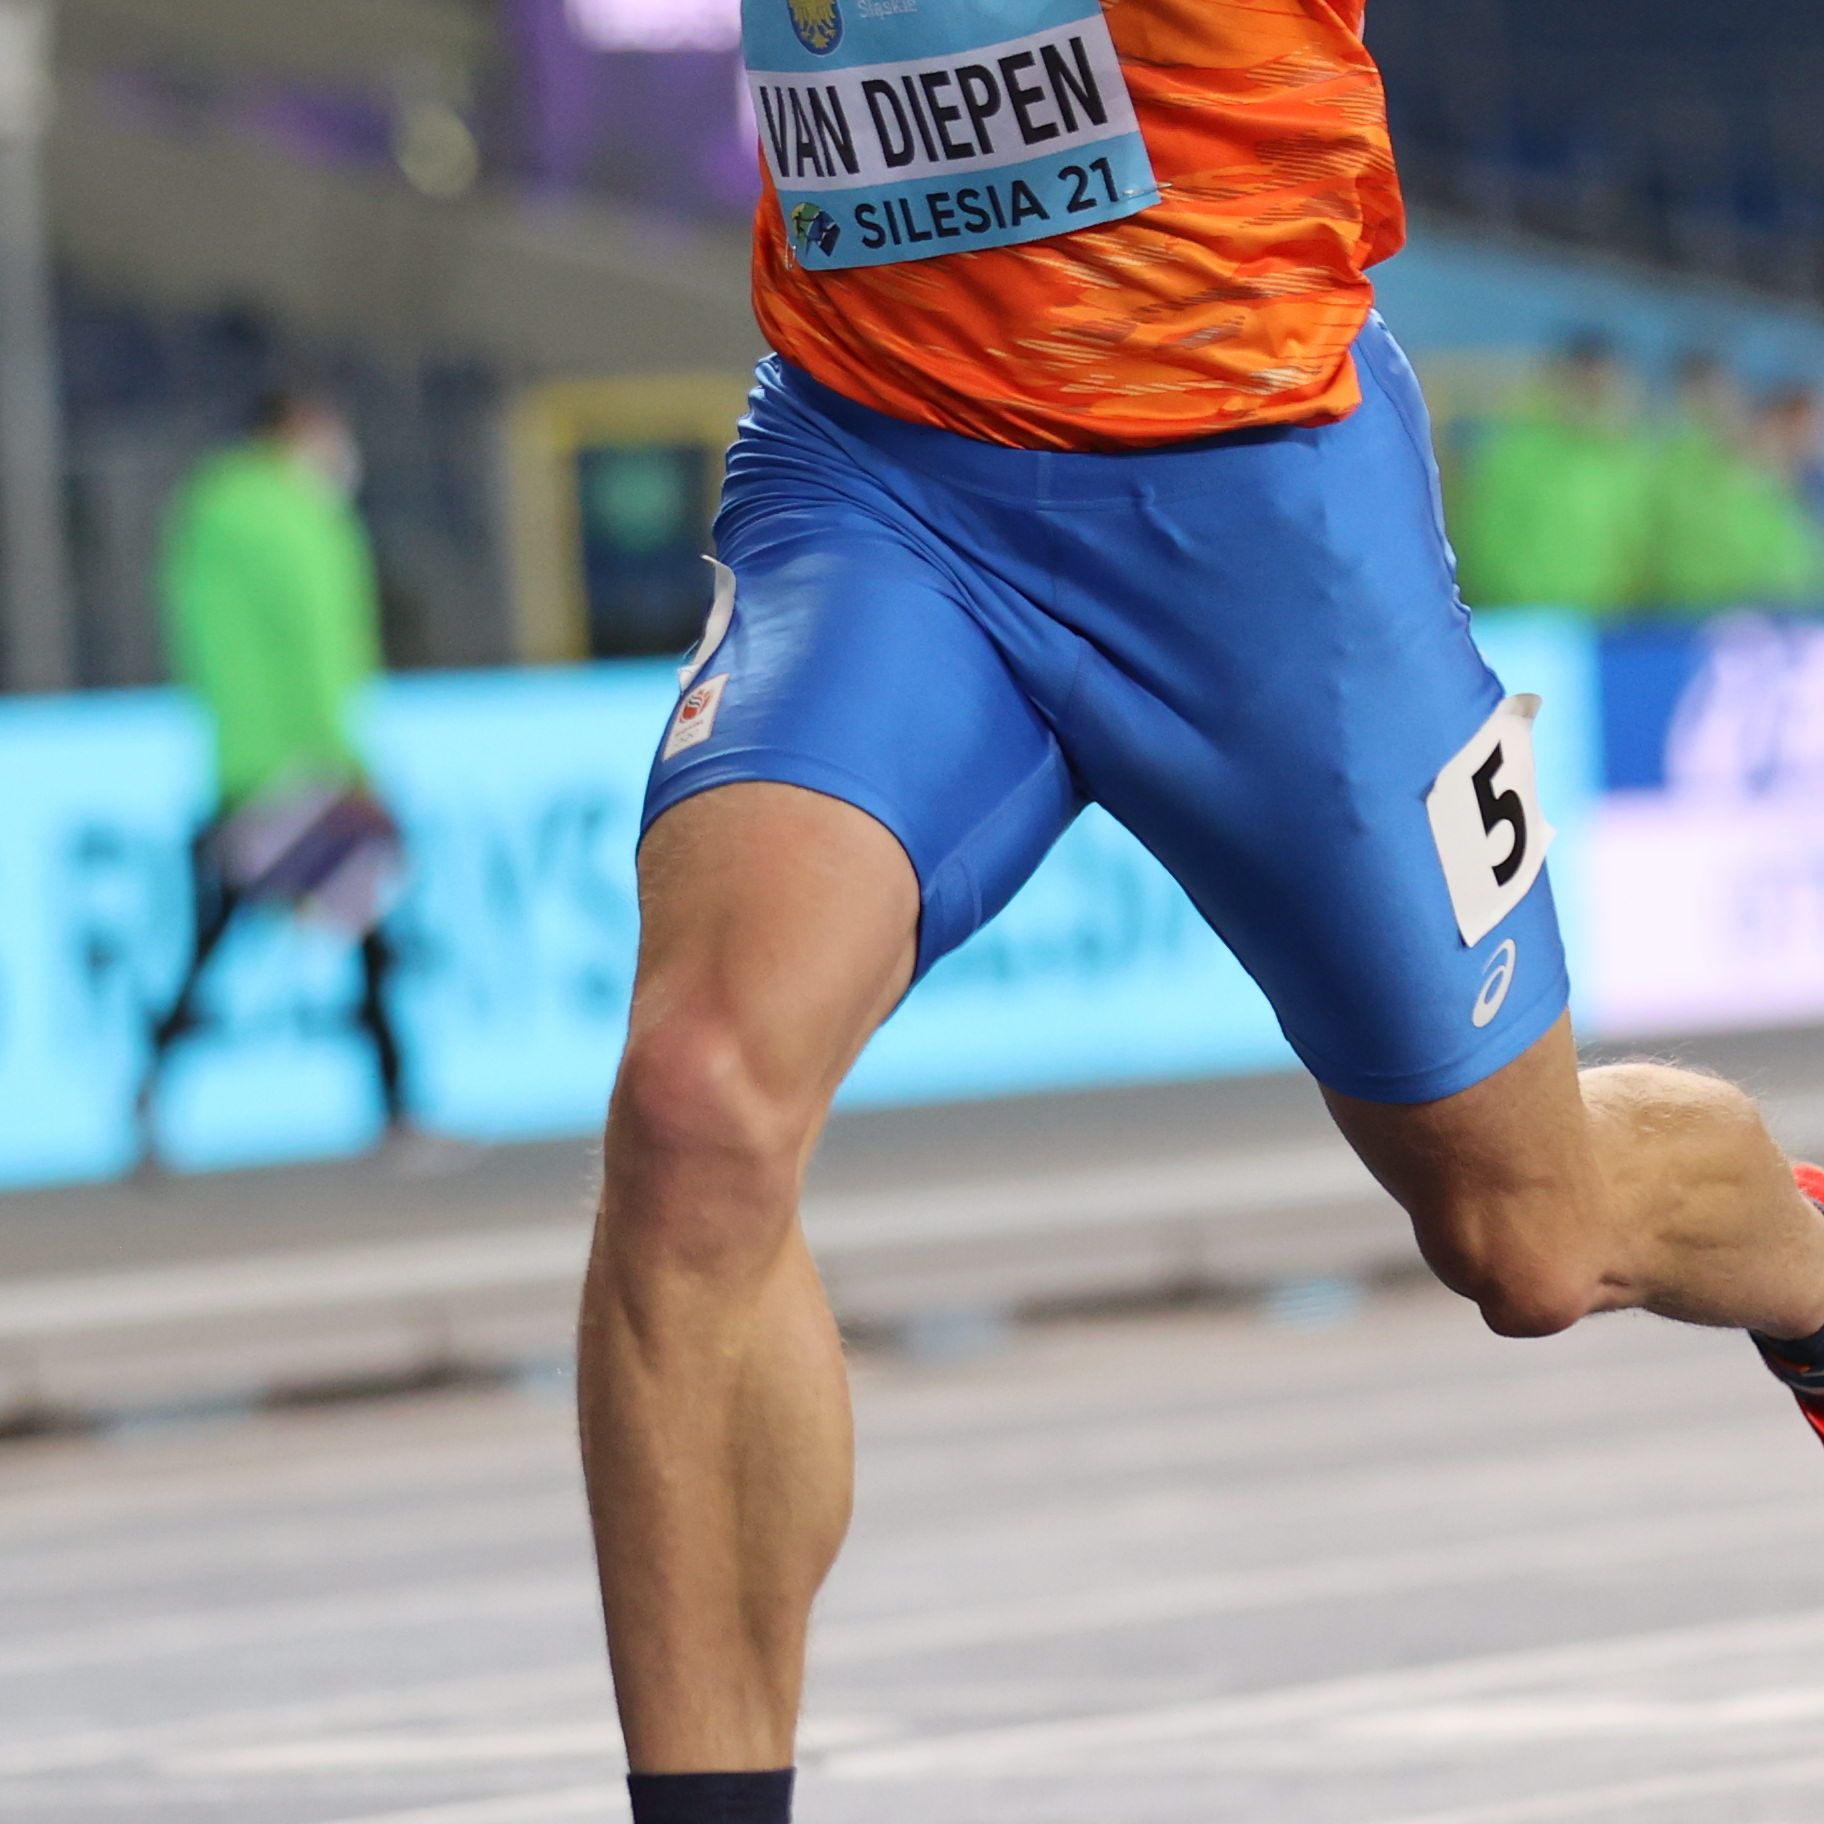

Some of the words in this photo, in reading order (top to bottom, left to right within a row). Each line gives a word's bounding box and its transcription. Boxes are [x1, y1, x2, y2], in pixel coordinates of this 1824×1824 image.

[759, 85, 860, 178] VAN
[862, 36, 1108, 169] DIEPEN
[854, 178, 1050, 250] SILESIA
[1058, 157, 1120, 214] 21
[1471, 738, 1527, 888] 5
